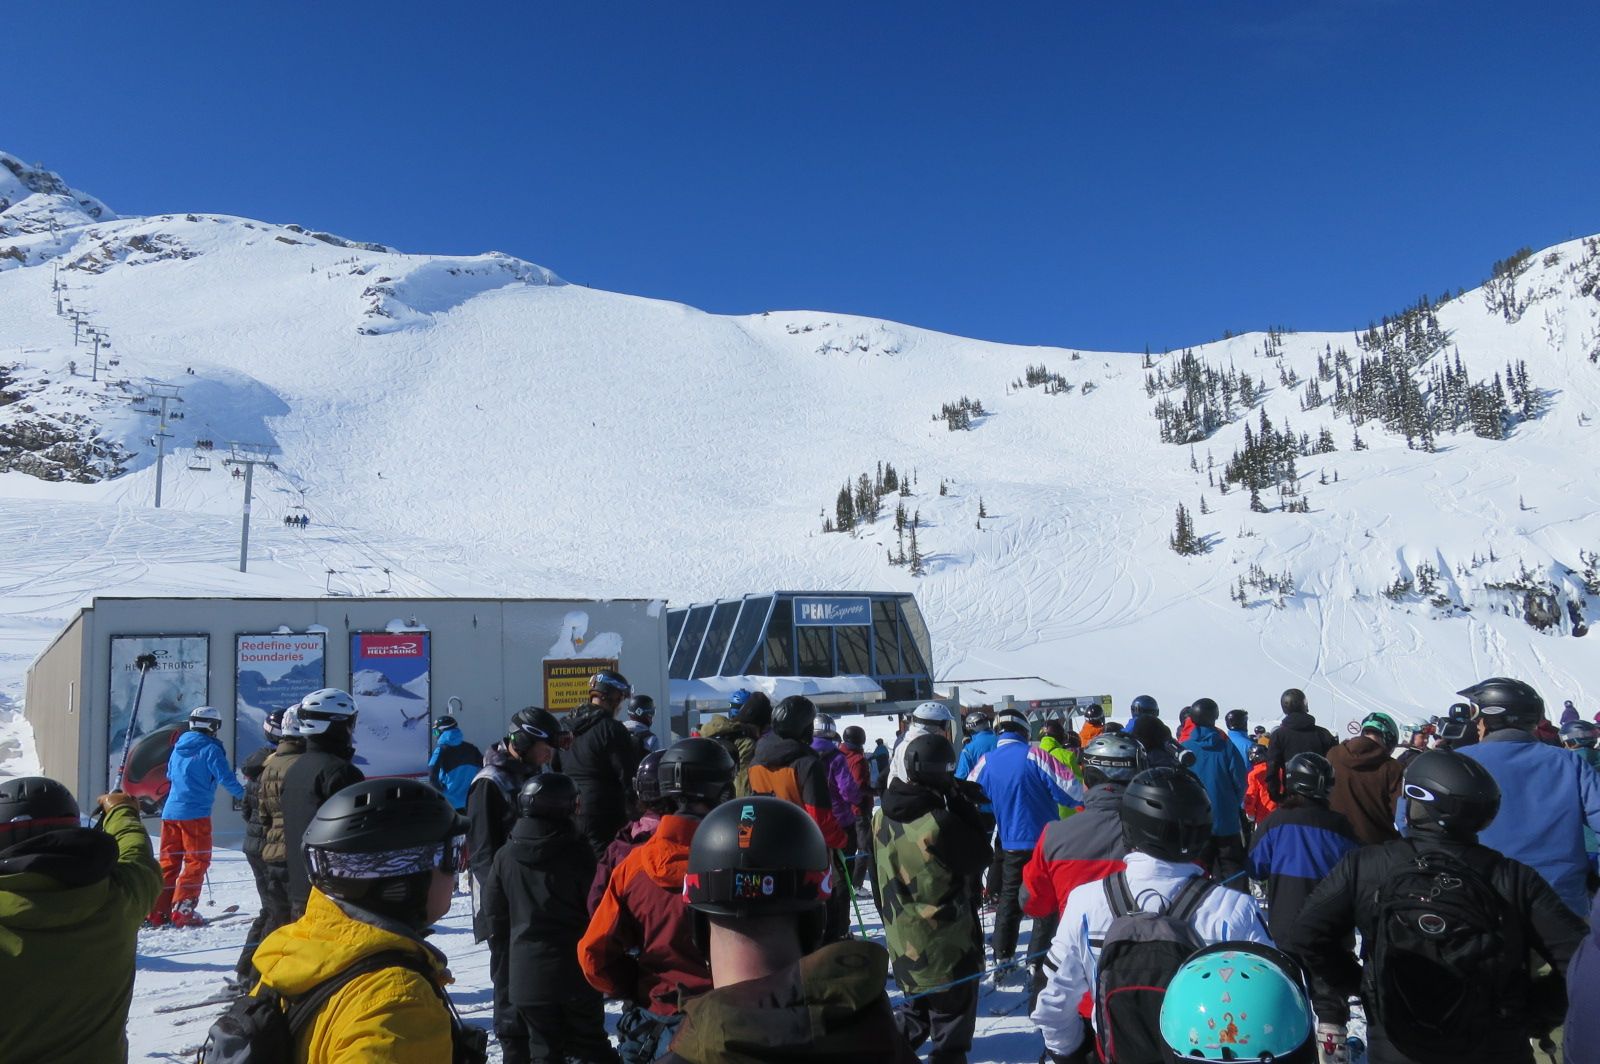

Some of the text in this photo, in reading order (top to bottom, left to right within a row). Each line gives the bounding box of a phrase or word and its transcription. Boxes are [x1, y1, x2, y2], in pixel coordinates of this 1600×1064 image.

[801, 603, 864, 619] PEAK Express
[241, 641, 319, 651] Redefine your
[241, 652, 304, 662] boundaries
[551, 667, 586, 675] ATTENTION
